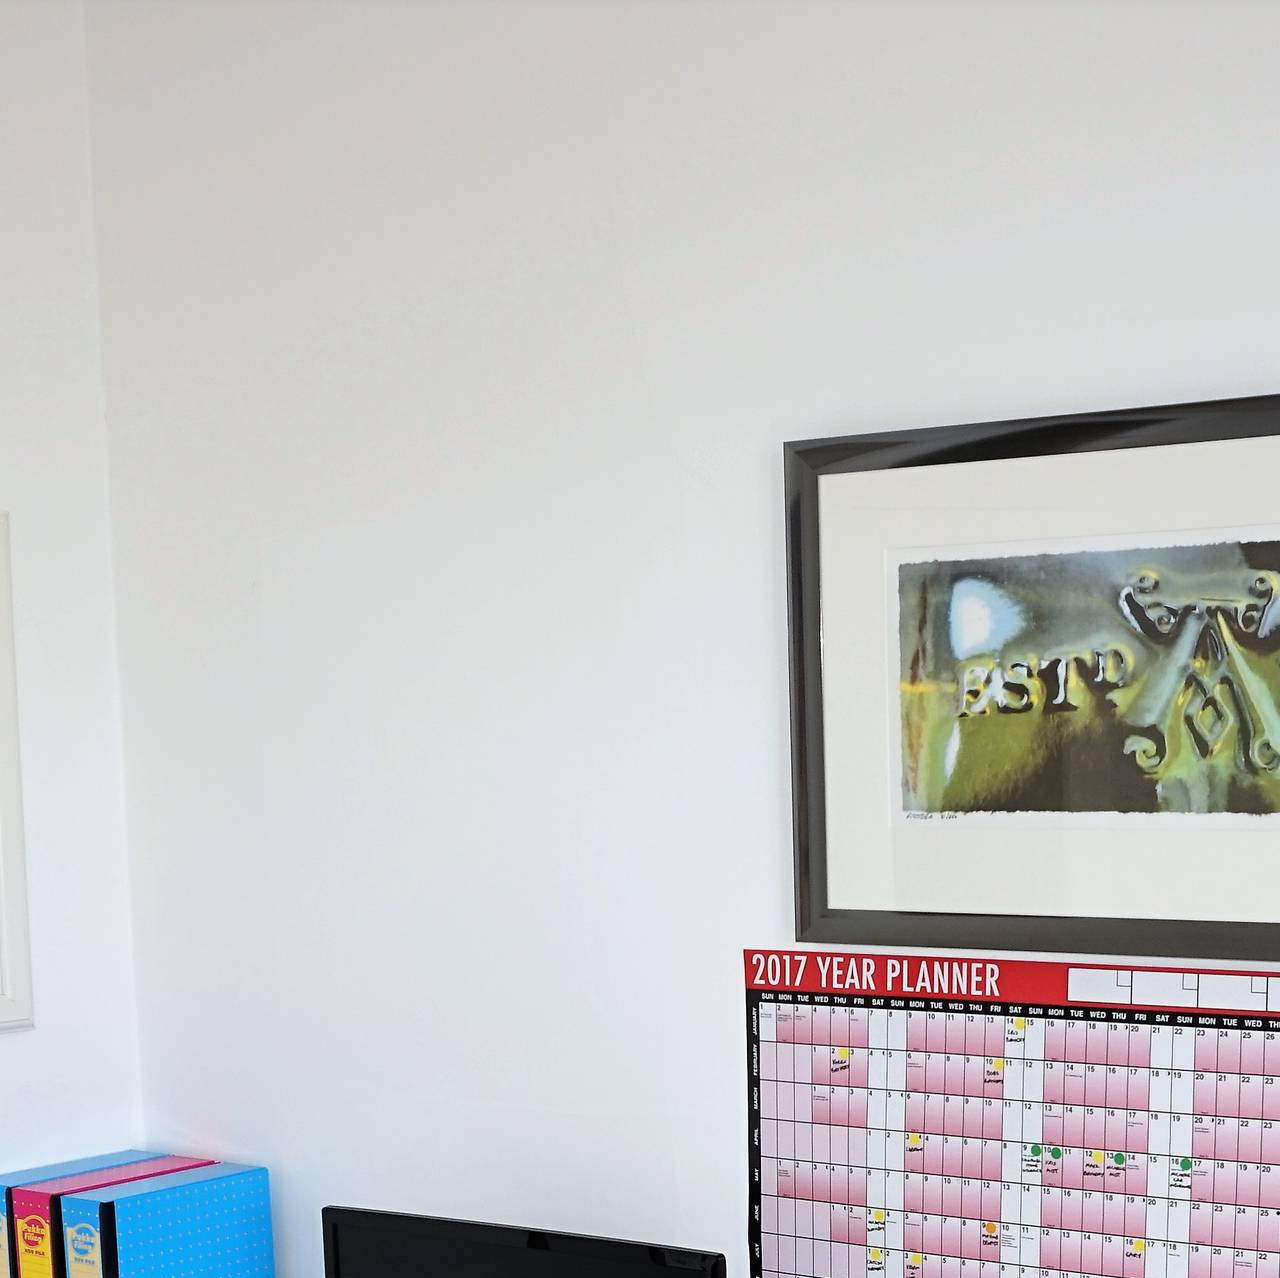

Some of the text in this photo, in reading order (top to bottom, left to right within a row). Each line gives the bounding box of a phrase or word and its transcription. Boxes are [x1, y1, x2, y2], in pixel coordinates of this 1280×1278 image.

[752, 953, 1000, 997] 2017 YEAR PLANNER
[761, 992, 775, 1000] SUN
[778, 993, 793, 1001] MON
[797, 994, 810, 1003] TUE
[814, 995, 830, 1003] WED
[833, 996, 847, 1004] THU
[853, 997, 865, 1005] FRI
[871, 998, 885, 1006] SAT
[890, 999, 905, 1007] SUN
[909, 1000, 925, 1008] MON
[929, 1001, 944, 1010] TUE
[948, 1002, 964, 1011] WED
[968, 1003, 983, 1012] THU
[989, 1004, 1002, 1013] FRI
[1008, 1005, 1023, 1014] SAT
[1028, 1006, 1044, 1015] SUN
[1048, 1008, 1065, 1017] MON
[1069, 1009, 1084, 1018] TUE
[1089, 1010, 1107, 1019] WED
[1111, 1011, 1127, 1020] THU
[1134, 1013, 1147, 1021] FRI
[1155, 1014, 1170, 1023] SAT
[1176, 1015, 1193, 1024] SUN
[1198, 1016, 1217, 1025] MON
[1222, 1017, 1238, 1027] TUE
[1244, 1019, 1263, 1028] WED
